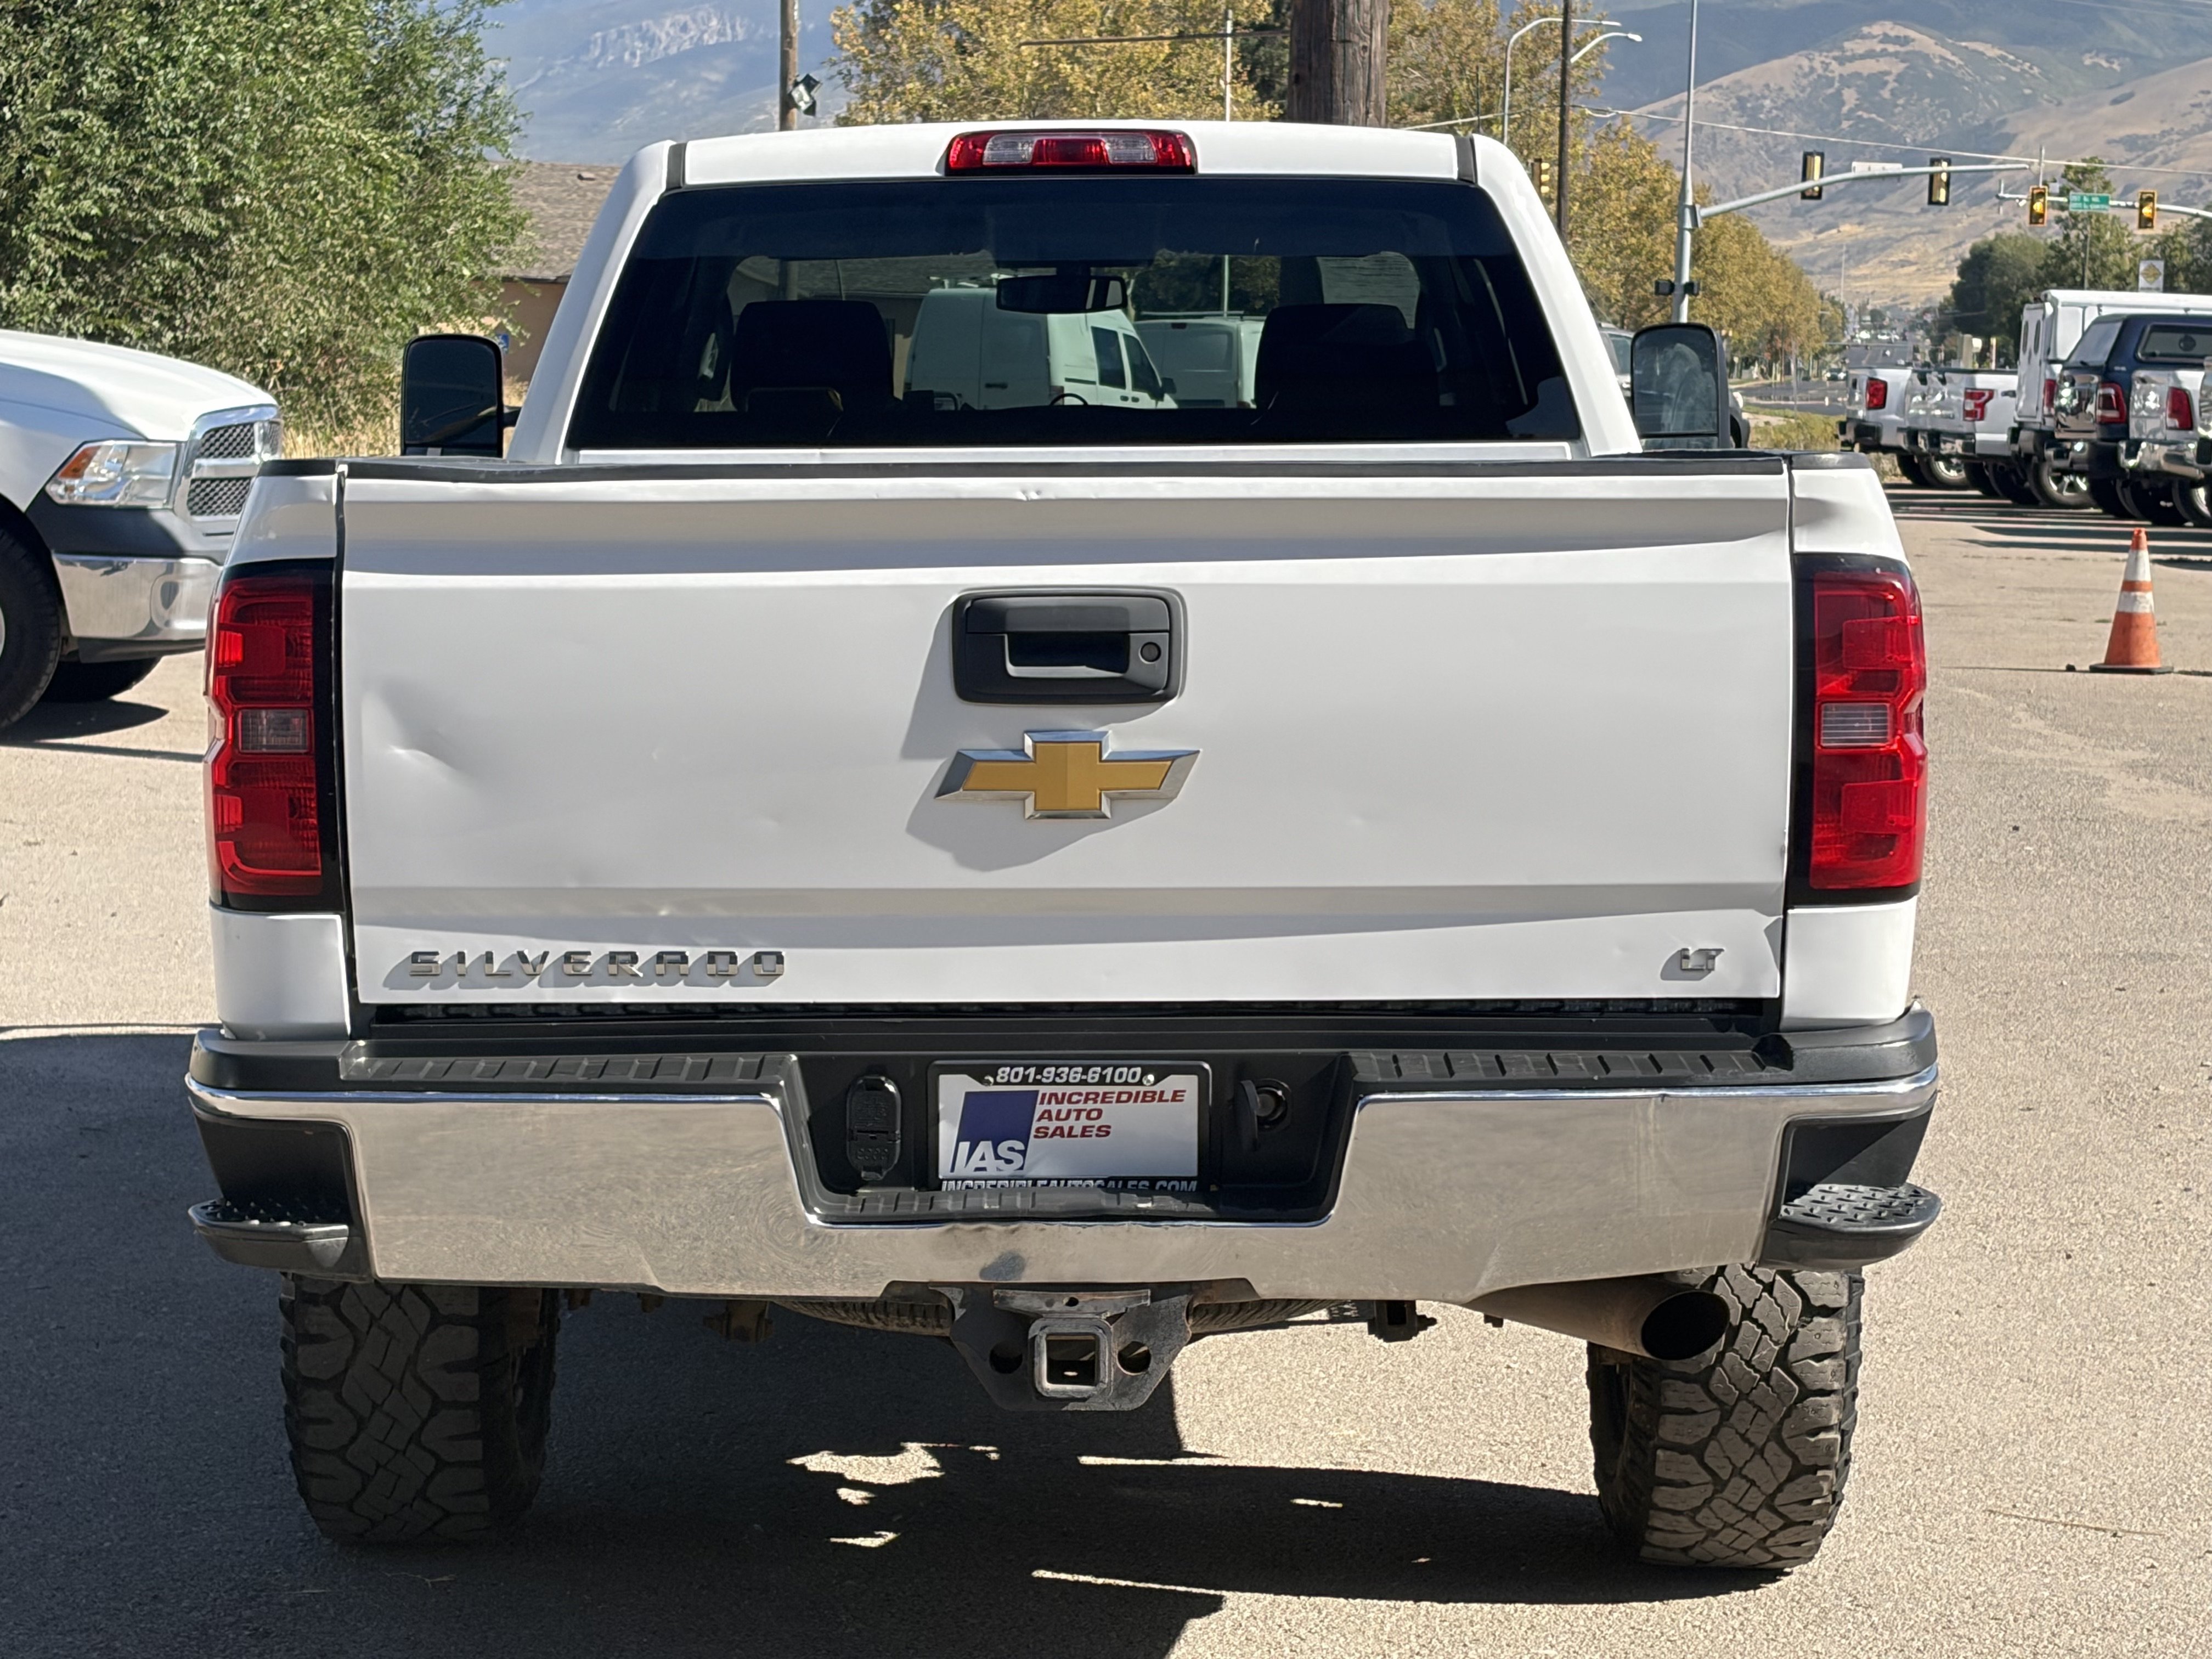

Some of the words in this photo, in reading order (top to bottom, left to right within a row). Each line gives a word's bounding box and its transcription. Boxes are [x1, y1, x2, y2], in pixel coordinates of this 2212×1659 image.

[409, 951, 784, 978] SILVERADO
[1680, 949, 1724, 970] LT
[996, 1067, 1142, 1083] 801-936-6100
[1039, 1090, 1186, 1105] INCREDIBLE
[1036, 1108, 1103, 1122] AUTO
[1033, 1125, 1111, 1139] SALES
[953, 1141, 1026, 1172] IAS
[941, 1180, 1197, 1192] INCREDIEATOSAESCOM
